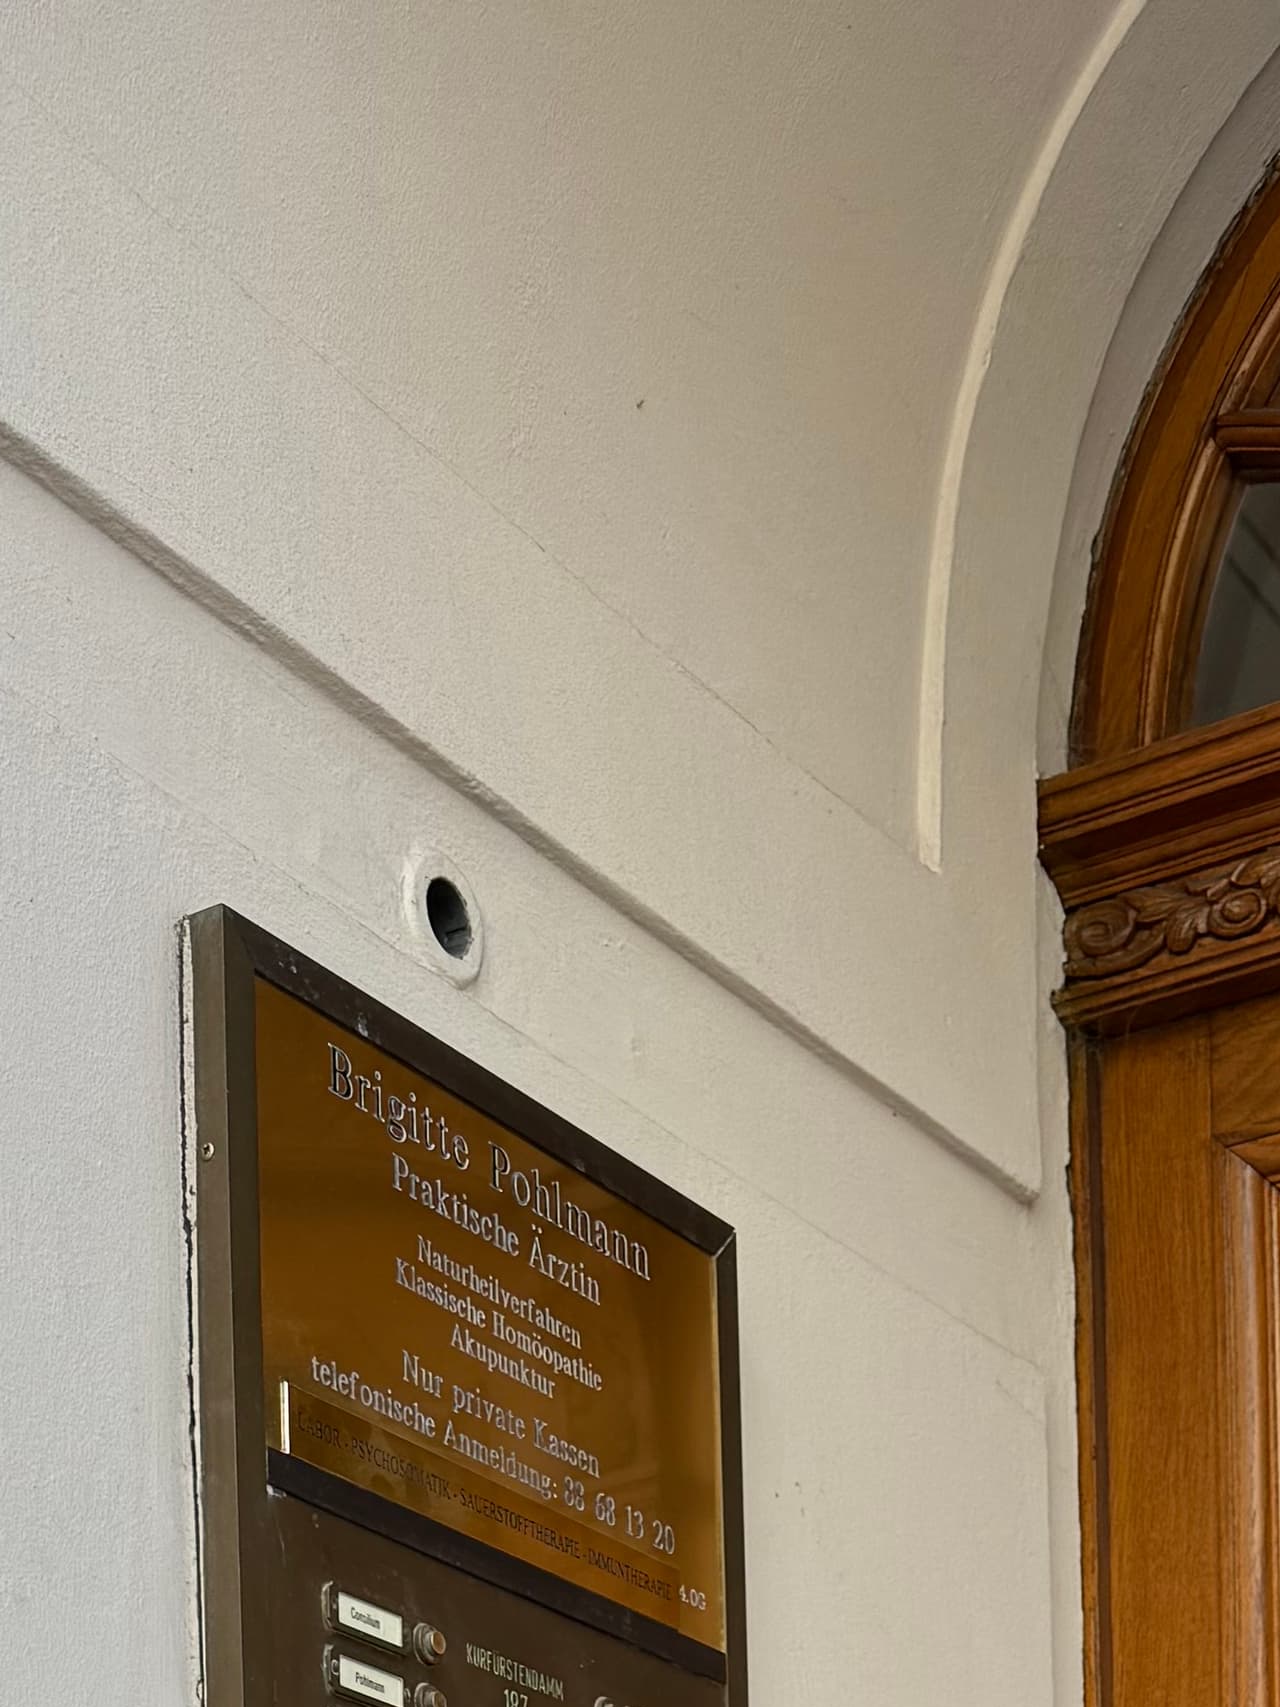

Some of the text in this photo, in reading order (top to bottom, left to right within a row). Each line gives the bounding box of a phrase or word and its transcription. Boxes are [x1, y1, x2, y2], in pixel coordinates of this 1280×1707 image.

[327, 1042, 651, 1281] Brigitte Pohlmann
[392, 1151, 601, 1306] Praktische Ärztin
[395, 1256, 603, 1391] Klassische Homöopathie
[417, 1234, 582, 1350] Naturheilverfahren
[450, 1323, 556, 1399] Akupunktur
[297, 1410, 342, 1449] LABOR
[459, 1488, 581, 1560] SAUERSTOFFTHERAPIE
[311, 1356, 436, 1438] telefonische
[443, 1419, 558, 1500] Anmeldung:
[595, 1493, 616, 1527] 68
[626, 1506, 644, 1539] 13
[652, 1520, 676, 1555] 20
[402, 1349, 600, 1479] Nur private Kassen
